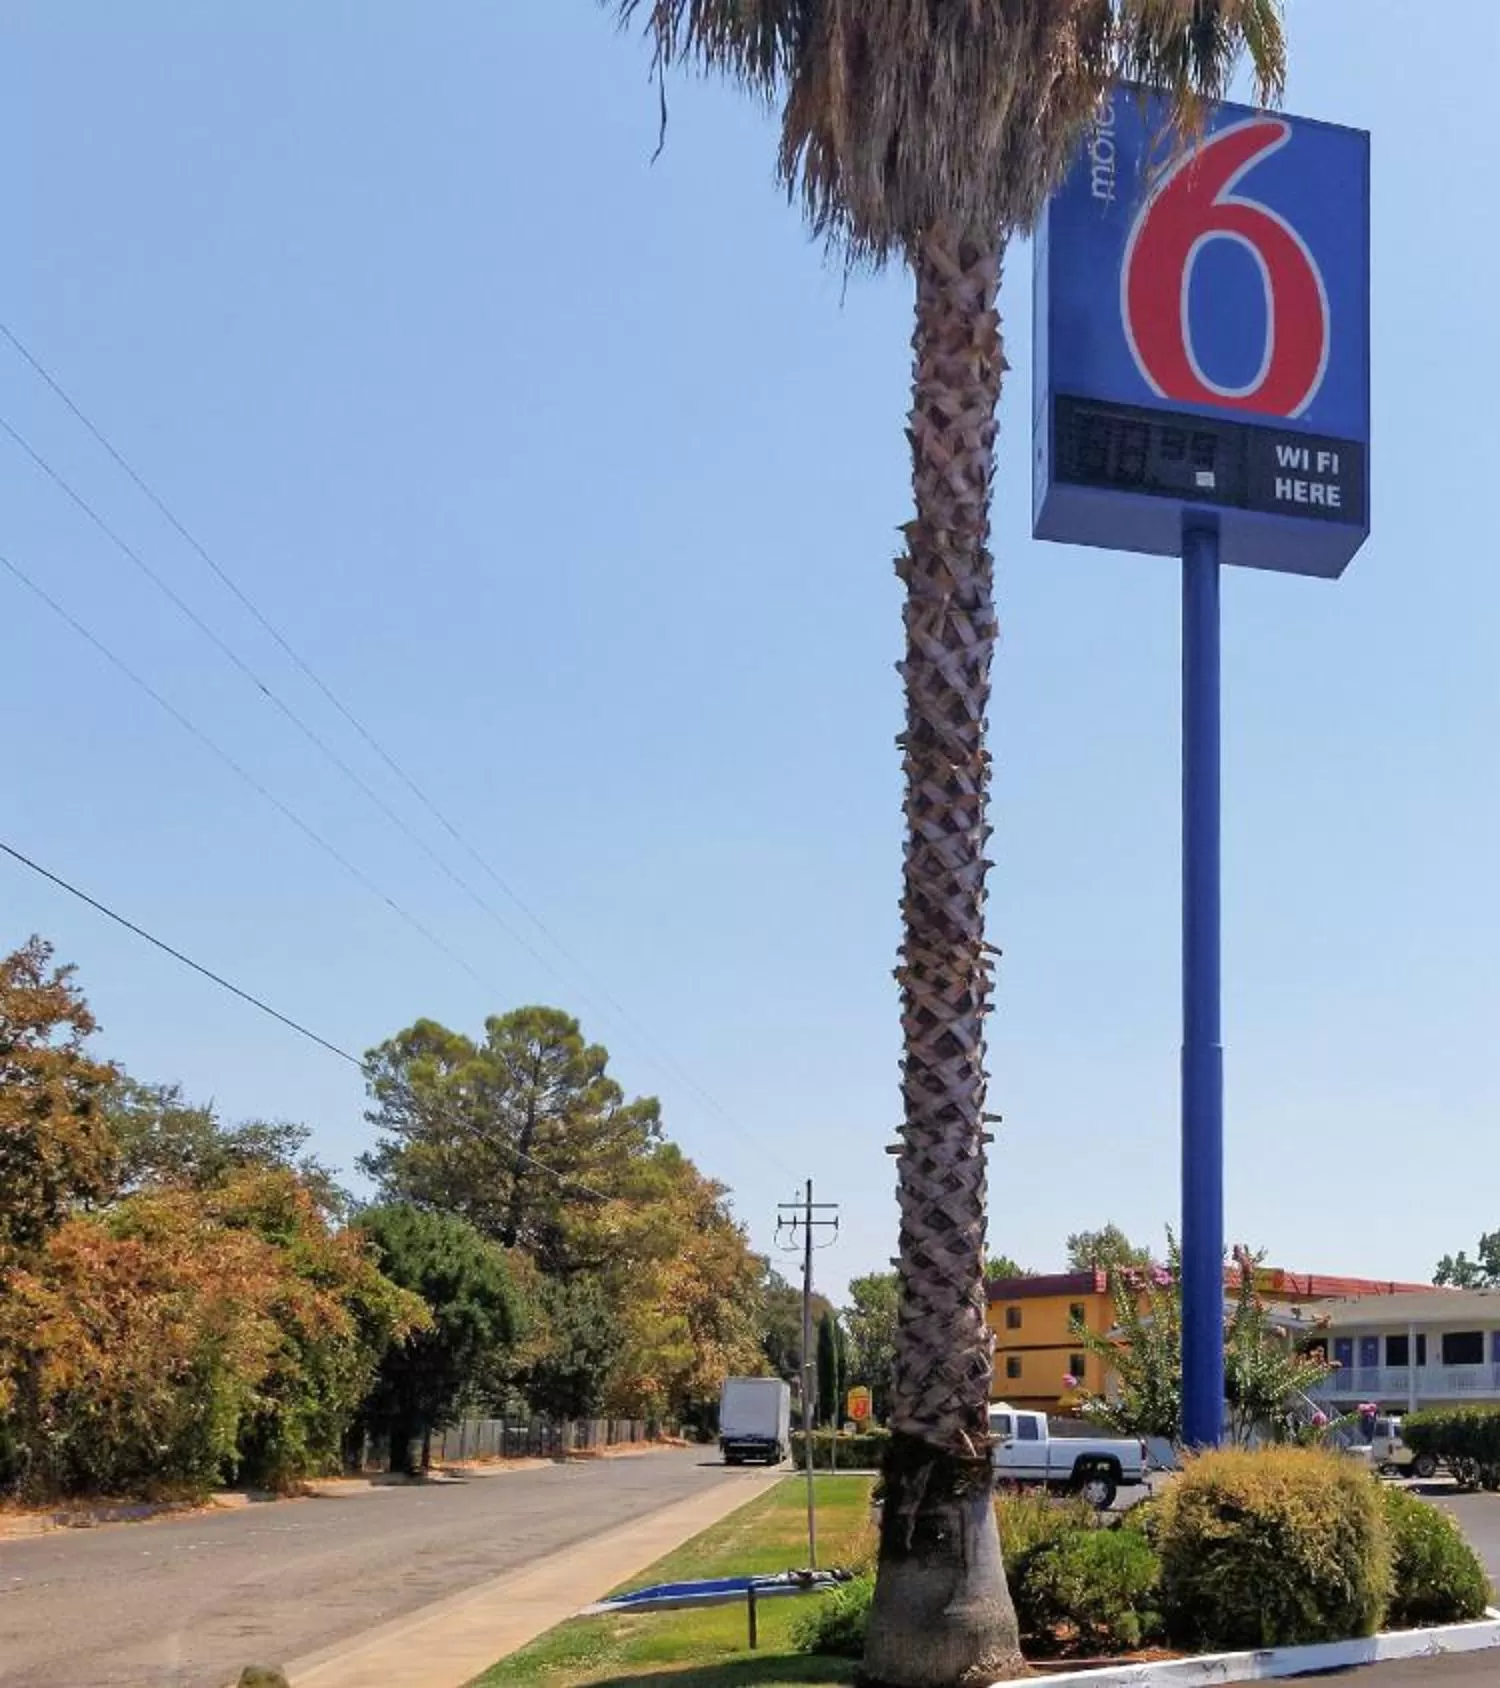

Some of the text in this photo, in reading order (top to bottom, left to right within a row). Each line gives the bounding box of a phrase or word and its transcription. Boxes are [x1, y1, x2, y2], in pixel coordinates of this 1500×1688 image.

[1091, 97, 1116, 200] mote
[1120, 117, 1330, 419] 6
[1275, 478, 1341, 507] HERE
[1276, 446, 1340, 475] WI FI
